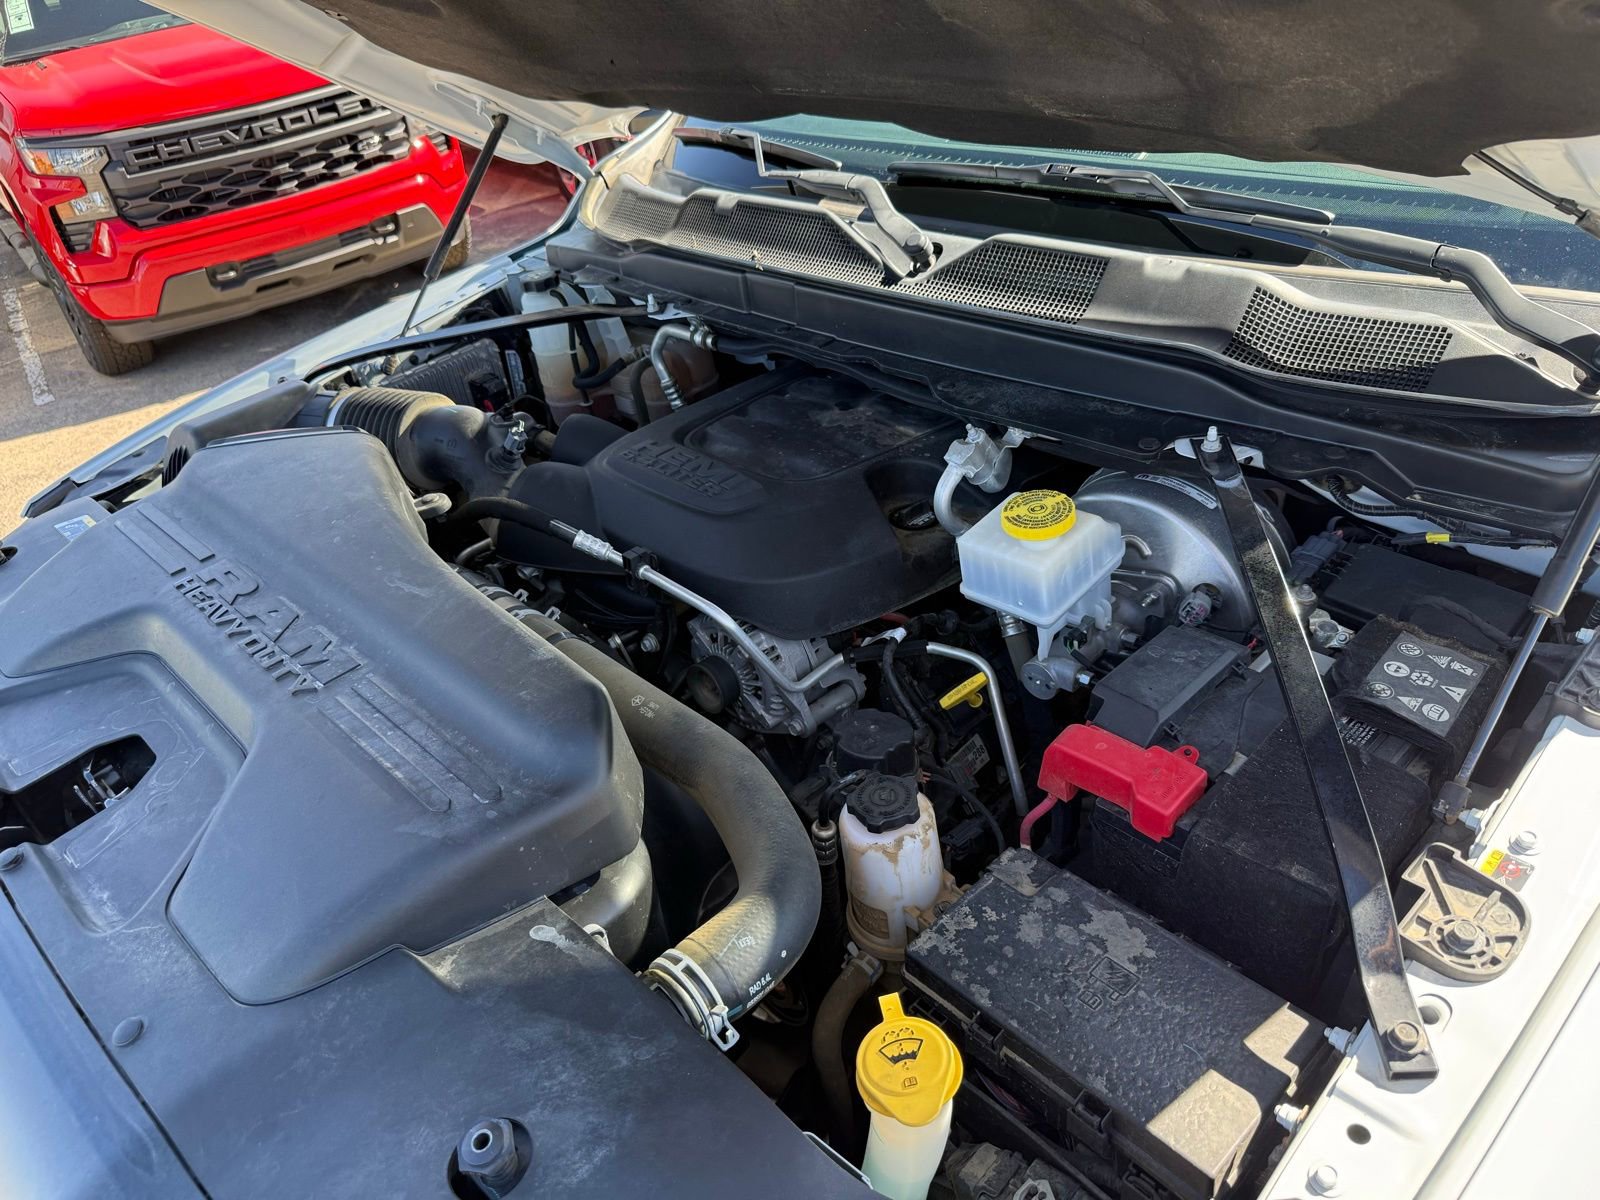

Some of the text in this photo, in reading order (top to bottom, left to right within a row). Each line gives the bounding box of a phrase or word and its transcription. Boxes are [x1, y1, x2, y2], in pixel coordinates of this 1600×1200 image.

[125, 98, 377, 164] CHEVROLE
[637, 440, 739, 491] HEMI
[174, 575, 322, 697] HEAVY DUTY
[195, 558, 363, 687] RAM
